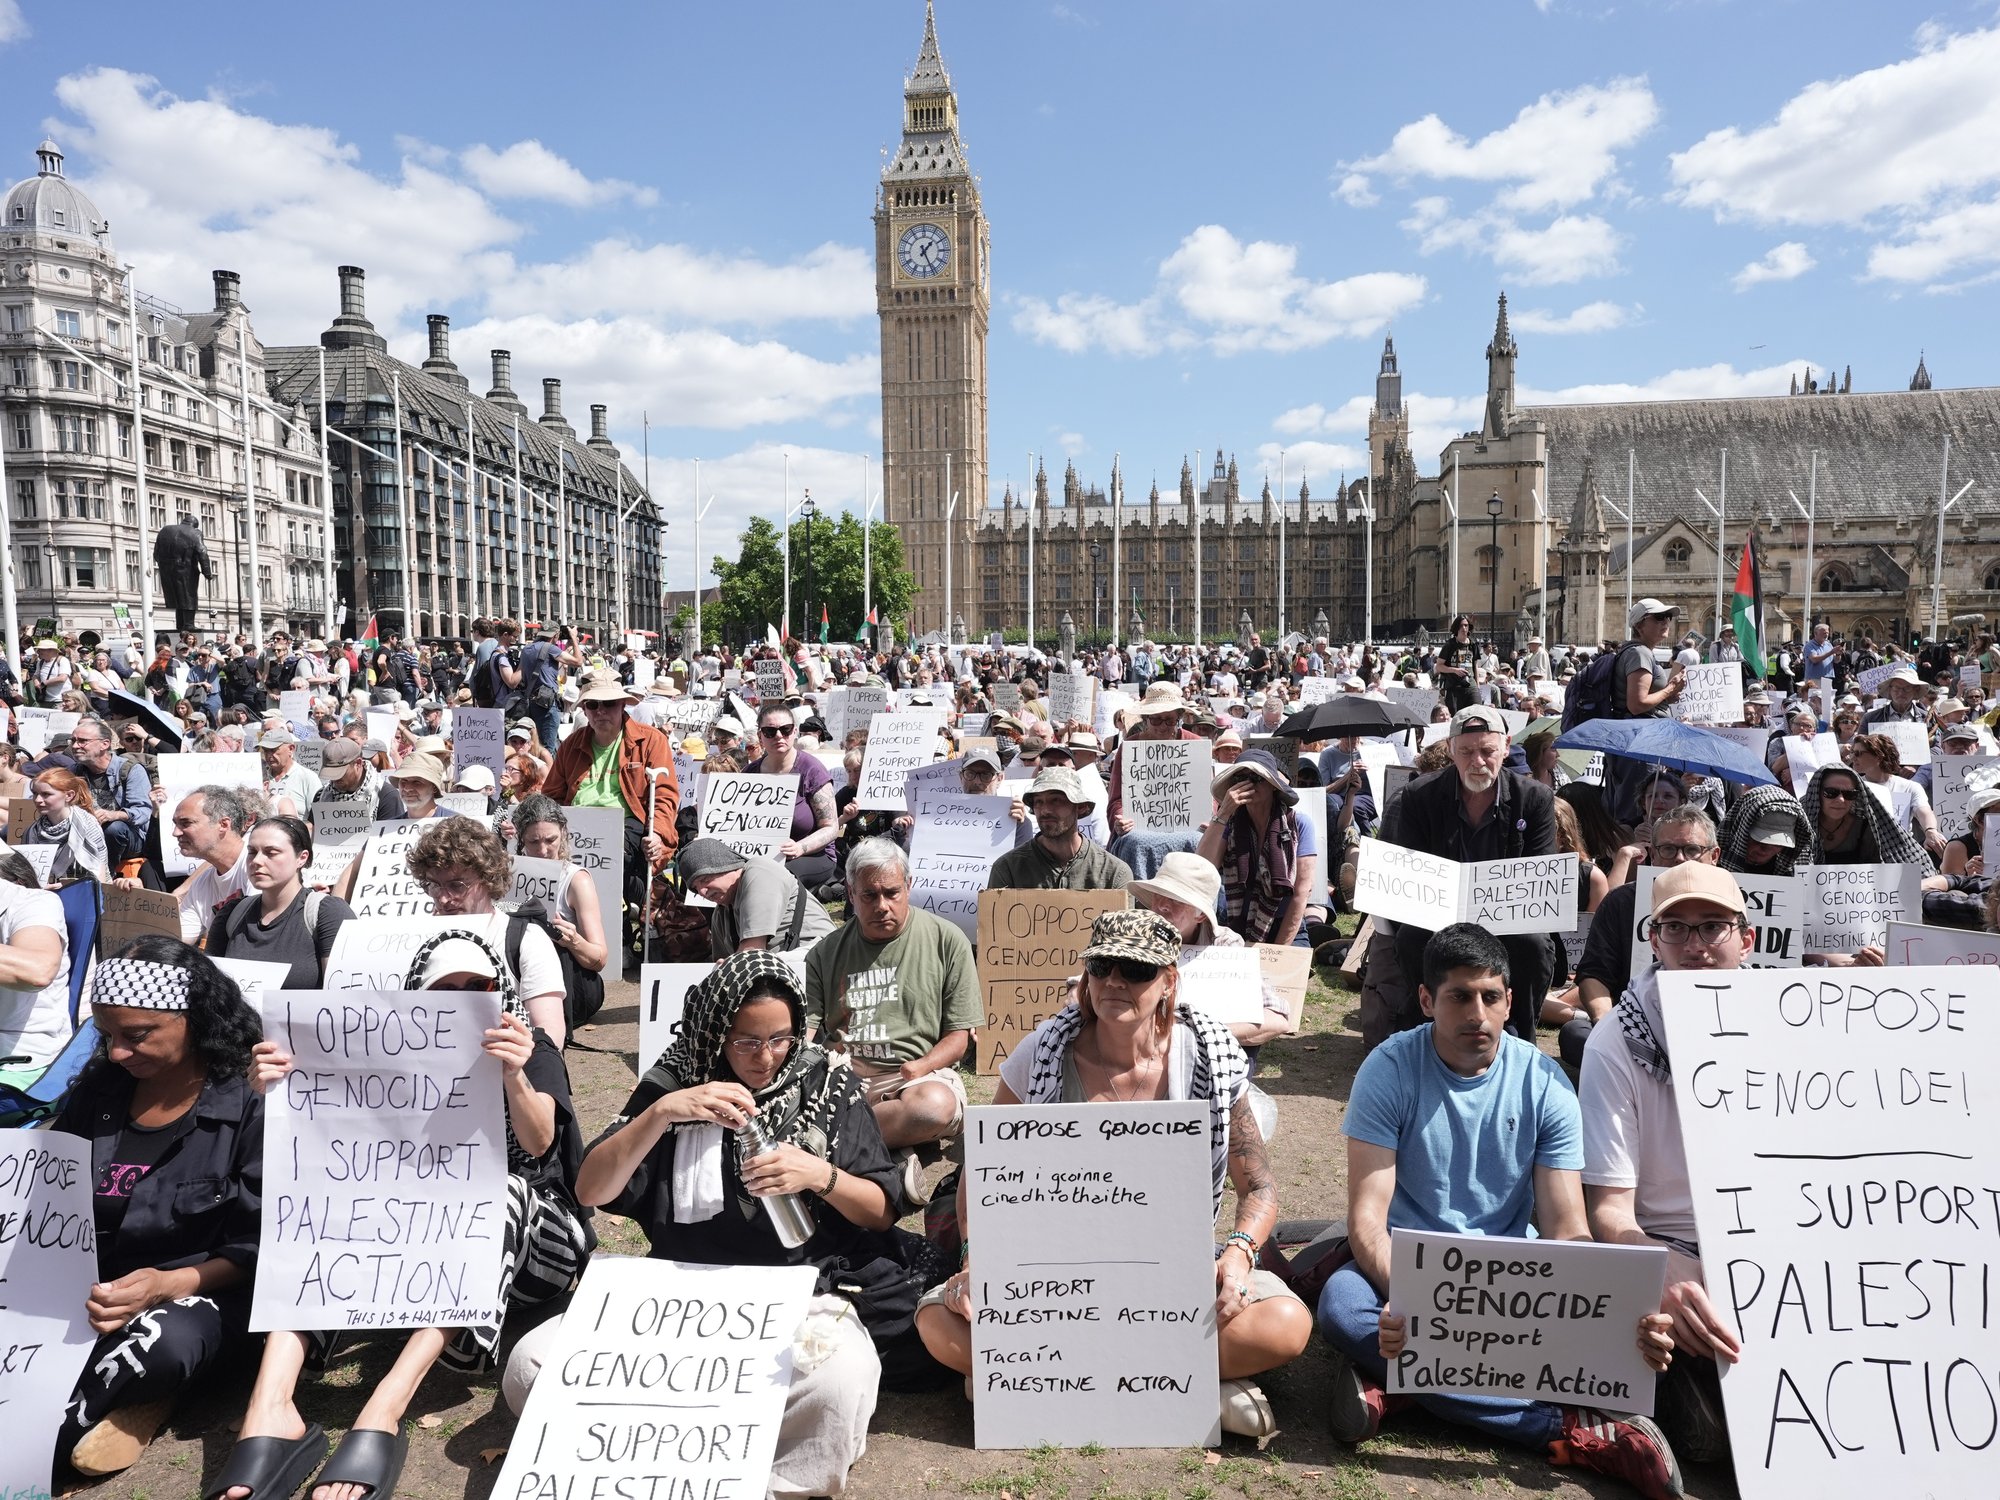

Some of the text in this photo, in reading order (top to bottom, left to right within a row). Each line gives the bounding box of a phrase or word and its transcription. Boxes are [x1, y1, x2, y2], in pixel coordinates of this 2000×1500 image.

[1686, 666, 1734, 689] PPOSE
[854, 690, 882, 703] OPPOSE
[1052, 694, 1090, 706] UPPORT
[1678, 687, 1723, 704] ENOCIDE
[1052, 709, 1089, 721] ACTION
[1677, 701, 1724, 714] SUPPORT
[458, 716, 462, 727] I
[855, 719, 871, 729] SUPP
[876, 722, 925, 734] I OPPOSE
[457, 730, 497, 741] GENOCIDE
[869, 736, 922, 745] GENOCIDE
[878, 757, 923, 767] SUPPORT
[1132, 743, 1190, 762] I OPPOSE
[868, 770, 908, 782] PALEST
[1130, 762, 1190, 781] GENOCIDE
[1936, 761, 1950, 777] I
[709, 779, 719, 804] I
[721, 780, 795, 806] OPPOSE
[1129, 781, 1191, 798] I SUPPORT
[18, 808, 23, 822] I
[321, 810, 368, 820] I OPPOSE
[921, 802, 986, 815] I OPPOSE
[1132, 795, 1192, 817] PALESTINE
[1936, 800, 1954, 816] I
[705, 808, 789, 833] GENOCIDE
[934, 818, 1002, 829] GENOCIDE
[1147, 812, 1190, 827] ACTION
[320, 826, 370, 836] GENOCIDE
[380, 826, 385, 838] I
[372, 866, 377, 877] I
[915, 858, 929, 870] I
[1382, 851, 1449, 879] OPPOSE
[1488, 856, 1577, 881] SUPPORT
[515, 873, 557, 902] POSE
[912, 876, 984, 890] PALESTIN
[1356, 868, 1451, 909] GENOCIDE
[1817, 871, 1875, 886] OPPOSE
[1473, 877, 1575, 905] PALESTINE
[360, 901, 435, 916] ACTIO
[922, 896, 977, 915] ACTIO
[1476, 899, 1560, 923] ACTION
[992, 901, 997, 941] I
[1823, 910, 1905, 925] SUPPORT
[341, 935, 348, 960] I
[986, 946, 1078, 967] GENOCID
[847, 966, 897, 989] THINK
[650, 980, 660, 1022] I
[847, 984, 898, 1008] WHILE
[1015, 986, 1068, 1004] SUPP
[848, 1008, 876, 1026] IT'S
[1694, 981, 1967, 1037] I OPPOSE
[287, 1001, 457, 1057] I OPPOSE
[844, 1024, 890, 1042] STILL
[843, 1043, 895, 1059] LEGAL
[288, 1069, 470, 1120] GENOCIDE
[1692, 1060, 1972, 1117] GENOCIDE!
[978, 1119, 1203, 1144] I OPPOSE GENOCIDE
[293, 1136, 480, 1181] I SUPPORT
[277, 1195, 493, 1245] PALESTINE
[1715, 1186, 1756, 1234] I
[0, 1202, 94, 1253] ENOCIDE
[1416, 1242, 1554, 1285] I Oppose
[296, 1252, 468, 1306] ACTION.
[984, 1278, 1096, 1305] I SUPPORT
[1433, 1281, 1612, 1319] GENOCIDE
[1727, 1259, 1989, 1344] PALESTI
[346, 1309, 376, 1326] THIS
[380, 1310, 395, 1326] IS
[399, 1311, 409, 1325] 4
[593, 1292, 784, 1340] I OPPOSE
[977, 1307, 1199, 1326] PALESTINE ACTION
[1411, 1316, 1542, 1354] I Support
[561, 1350, 755, 1394] GENOCIDE
[1397, 1350, 1630, 1399] Palestine Action
[987, 1372, 1193, 1394] PALESTINE ACTION
[1765, 1357, 2000, 1469] ACTIO
[533, 1422, 761, 1465] I SUPPORT
